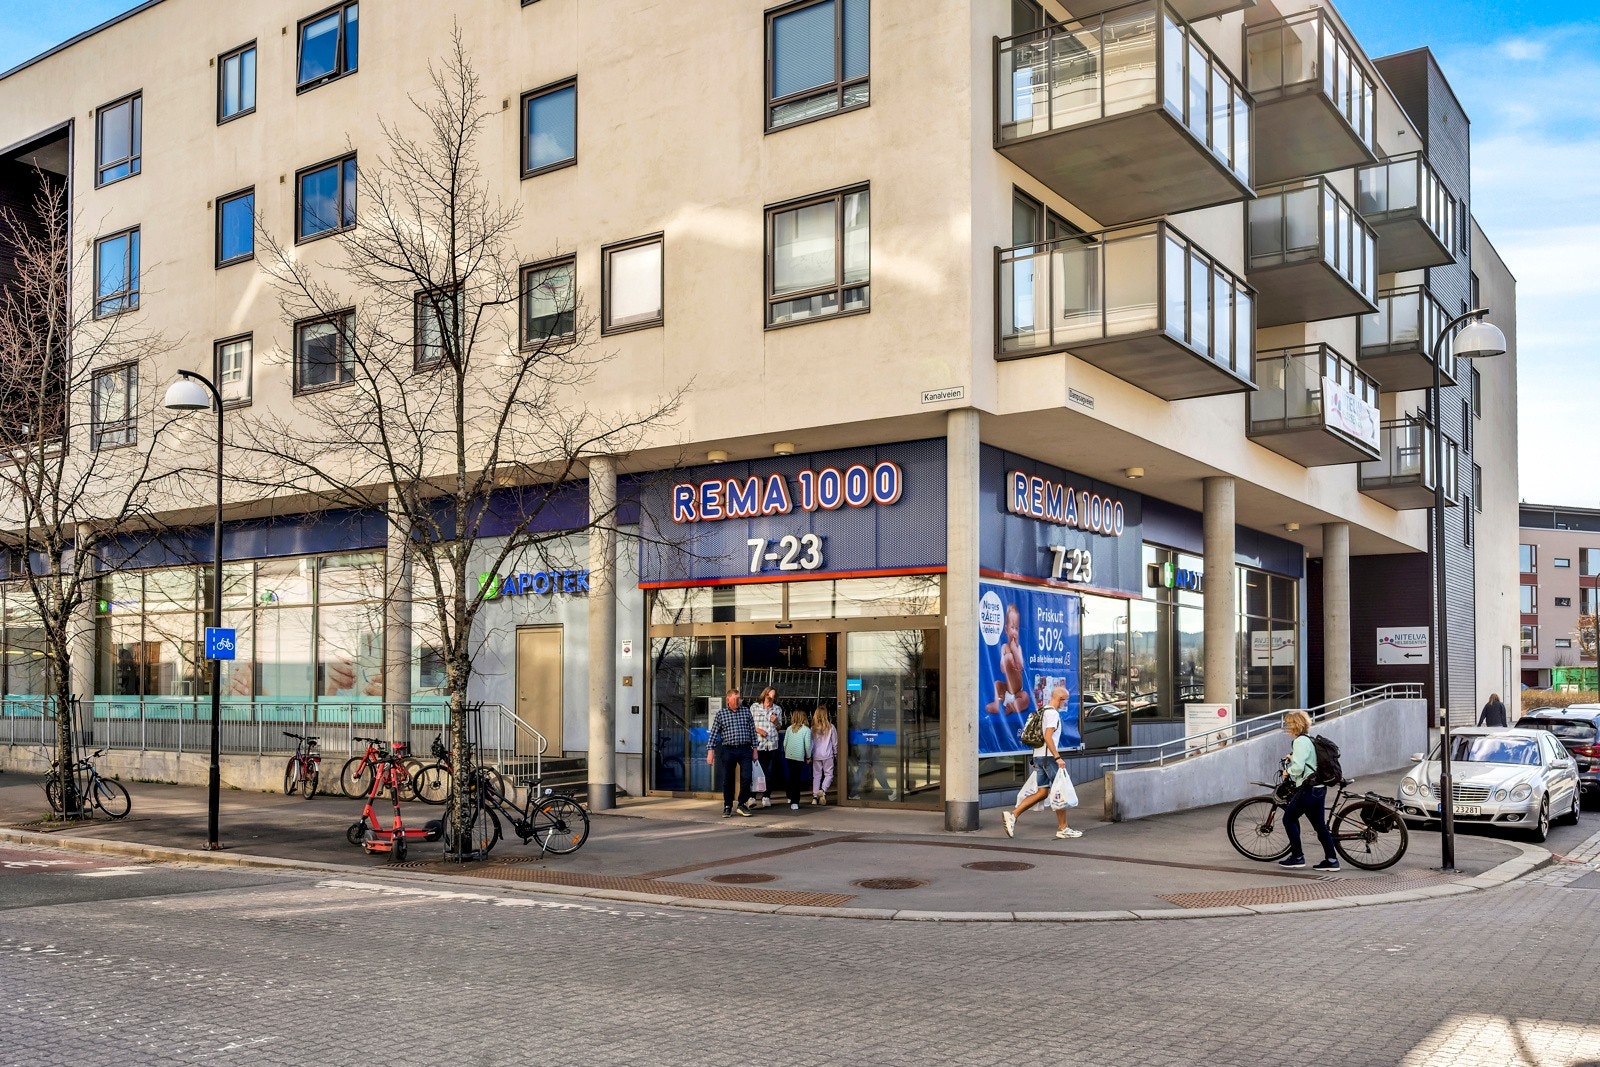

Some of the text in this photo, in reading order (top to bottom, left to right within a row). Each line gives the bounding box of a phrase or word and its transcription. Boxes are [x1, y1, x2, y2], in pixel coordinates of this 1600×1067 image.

[924, 390, 962, 401] Kanalveien
[672, 460, 902, 524] REMA 1000
[1012, 470, 1124, 537] REMA 1000
[748, 533, 824, 573] 7-23
[1050, 544, 1092, 583] 7-23
[501, 569, 590, 596] APOTEK
[983, 601, 1000, 611] Norges
[1038, 626, 1064, 651] 50%
[1030, 654, 1036, 664] på
[1455, 806, 1478, 814] 23281
